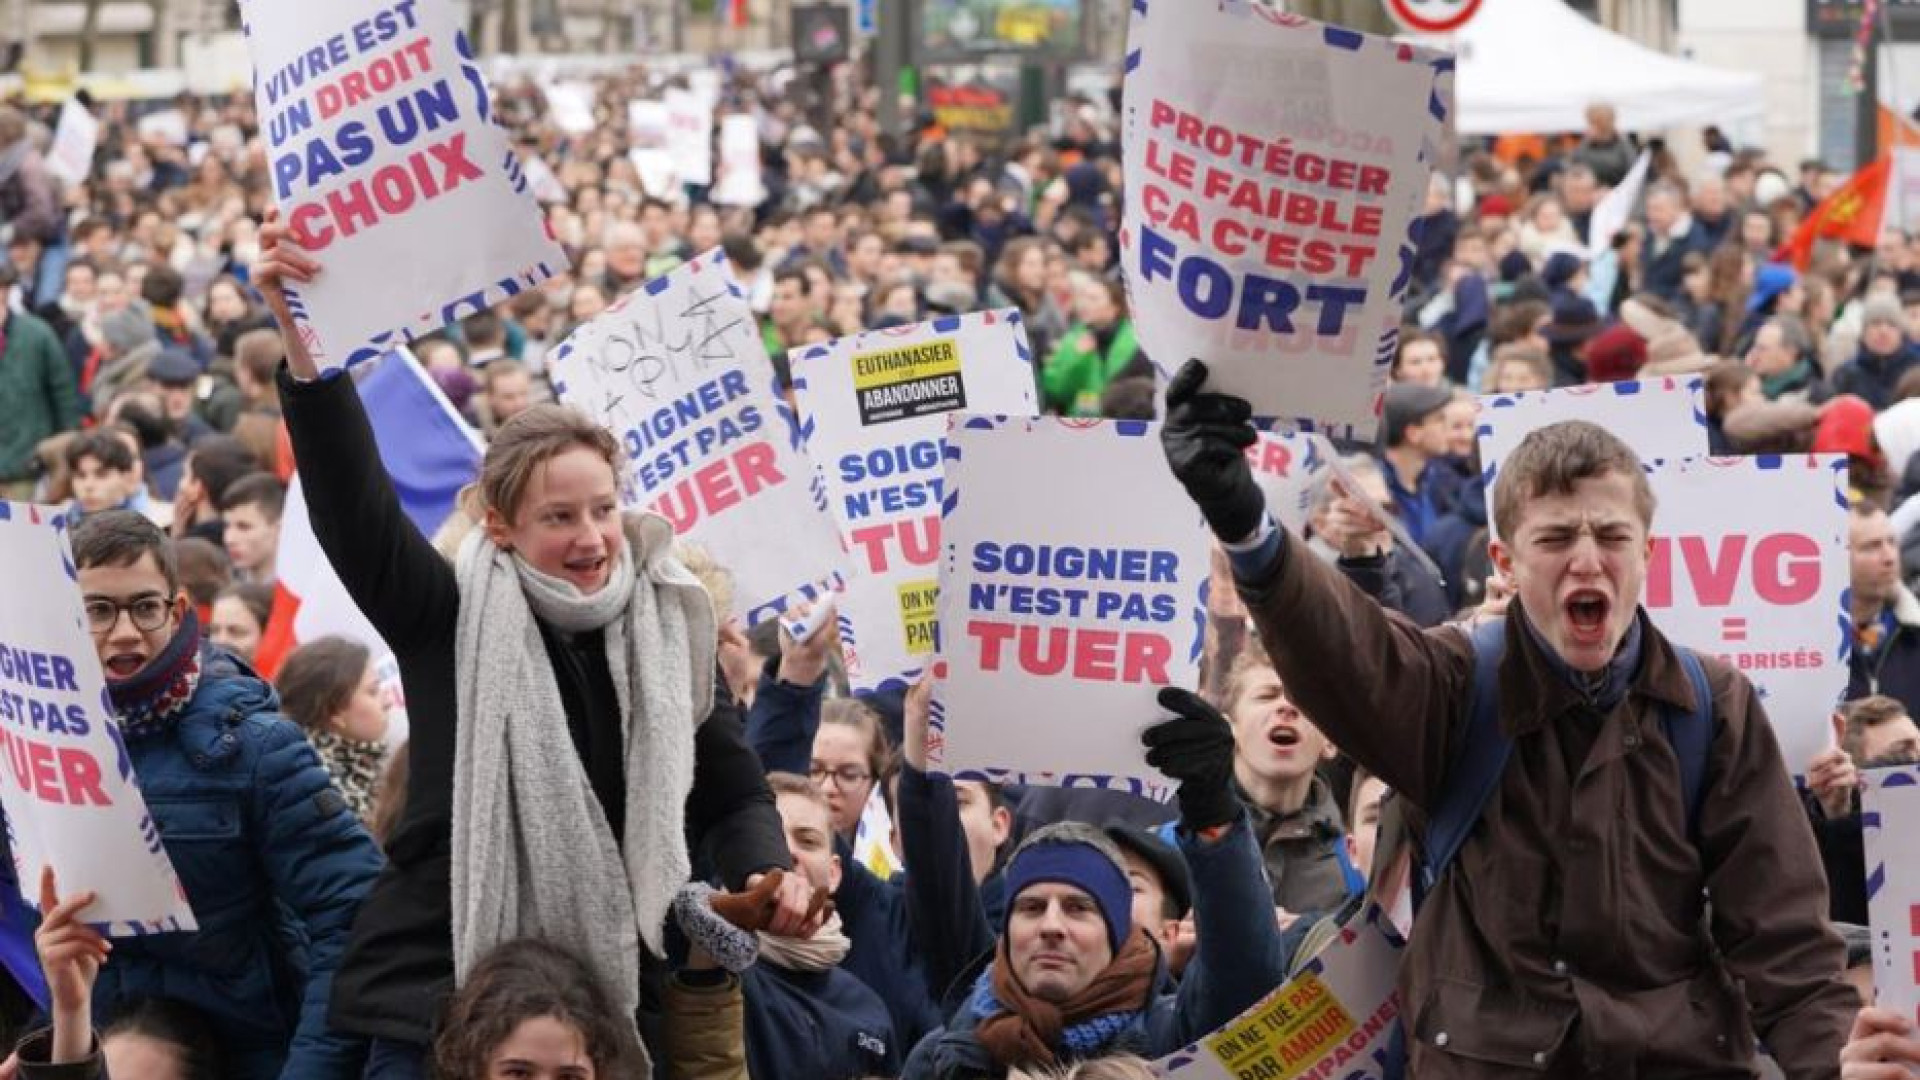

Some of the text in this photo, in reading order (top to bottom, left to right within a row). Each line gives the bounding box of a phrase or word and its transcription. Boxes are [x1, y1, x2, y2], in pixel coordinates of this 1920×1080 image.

[265, 0, 417, 105] VIVRE EST
[270, 36, 432, 147] UN DROIT
[275, 79, 460, 200] PAS UN
[1151, 98, 1392, 195] PROTÉGER
[289, 131, 485, 252] CHOIX
[1145, 139, 1384, 236] LE FAIBLE
[1142, 183, 1377, 279] ÇA C'EST
[1139, 223, 1368, 337] FORT
[857, 342, 952, 377] EUTHANASIER
[863, 375, 960, 410] ABANDONNER
[624, 369, 751, 461] OIGNER
[696, 405, 763, 456] PAS
[649, 441, 786, 535] UER
[973, 540, 1179, 583] SOIGNER
[1646, 532, 1822, 608] IVG
[969, 583, 1176, 622] N'EST PAS
[967, 620, 1172, 684] TUER
[1738, 646, 1824, 669] BRISÉS
[28, 698, 91, 737] PAS
[0, 724, 114, 806] UER
[1262, 1003, 1294, 1032] TUE
[1290, 978, 1324, 1010] PAS
[1277, 1004, 1348, 1068] AMOUR
